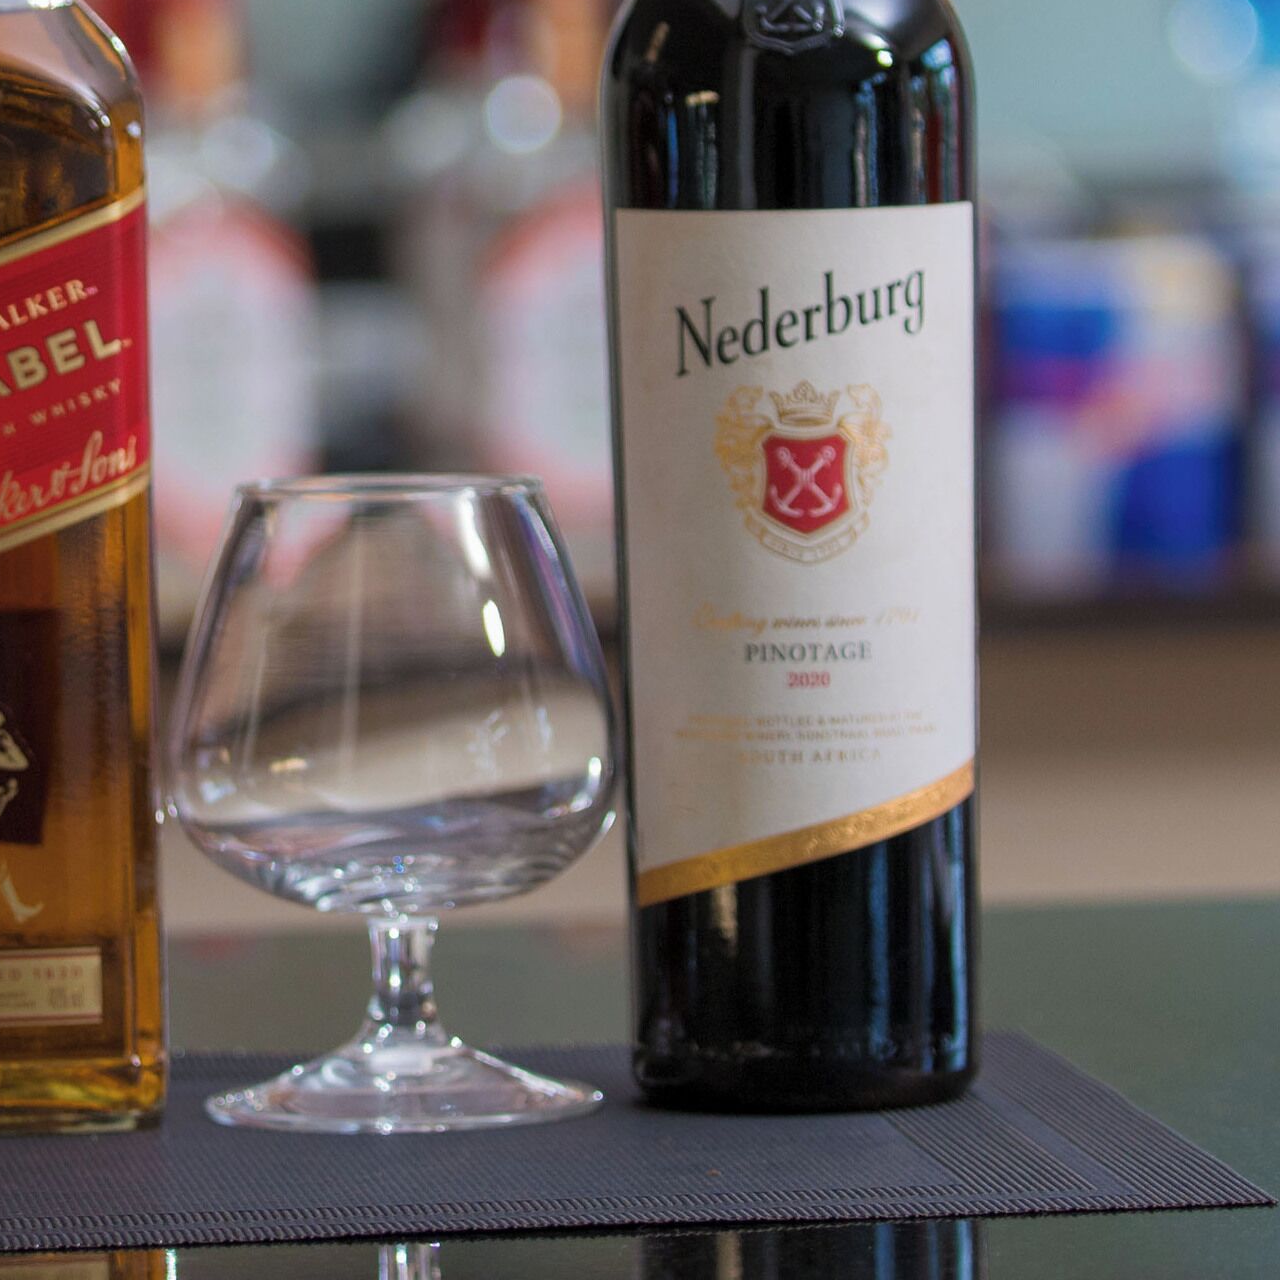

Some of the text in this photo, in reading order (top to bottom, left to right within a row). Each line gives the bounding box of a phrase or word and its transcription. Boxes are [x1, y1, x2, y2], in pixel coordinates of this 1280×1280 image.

[674, 268, 926, 379] Nederburg
[29, 377, 121, 426] WHISKY
[745, 640, 872, 663] PINOTAGE
